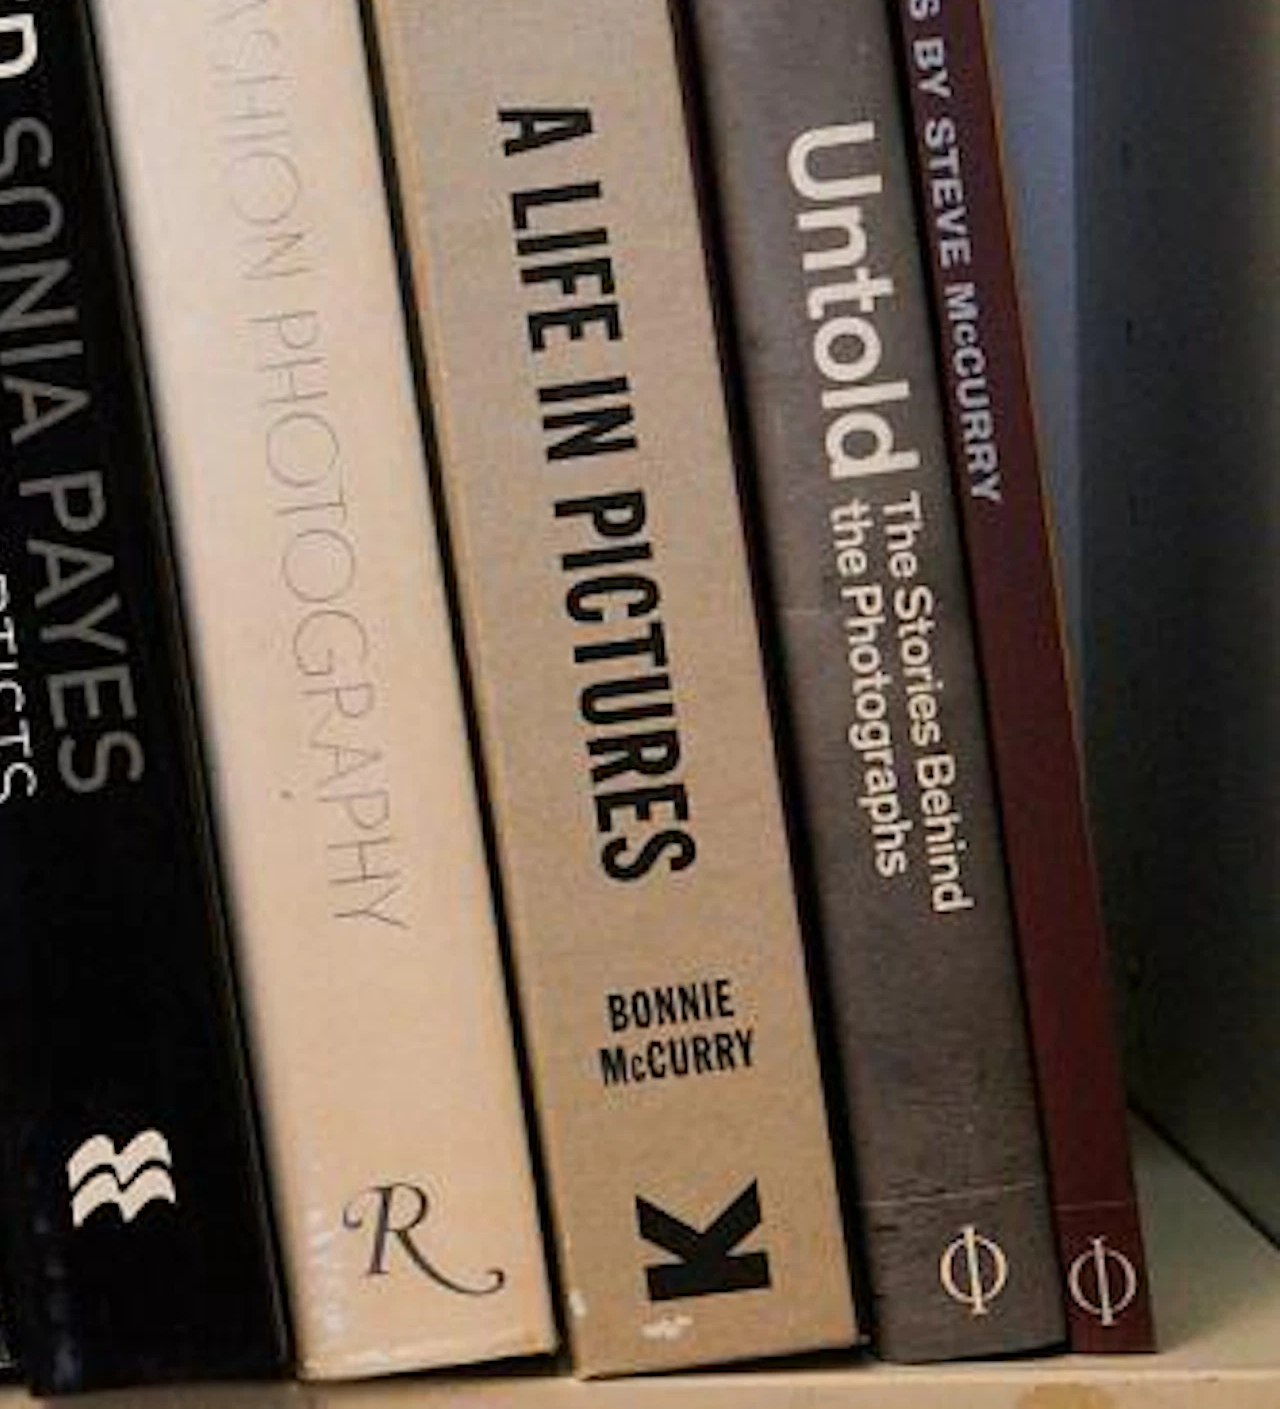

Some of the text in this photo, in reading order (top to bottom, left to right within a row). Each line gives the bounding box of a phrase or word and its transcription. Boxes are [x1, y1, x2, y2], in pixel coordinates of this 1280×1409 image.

[913, 37, 952, 99] BY
[924, 115, 972, 269] STEVE
[785, 120, 921, 481] Untold
[945, 281, 1003, 504] McCURRY
[18, 470, 145, 791] PAYES
[248, 309, 410, 930] PHOTOGRAPHY
[497, 106, 697, 886] A LIFE IN PICTURES
[826, 498, 913, 878] the Photographs
[883, 490, 974, 913] The Stories Behind
[599, 1028, 754, 1087] McCURRY
[607, 978, 735, 1032] BONNIE
